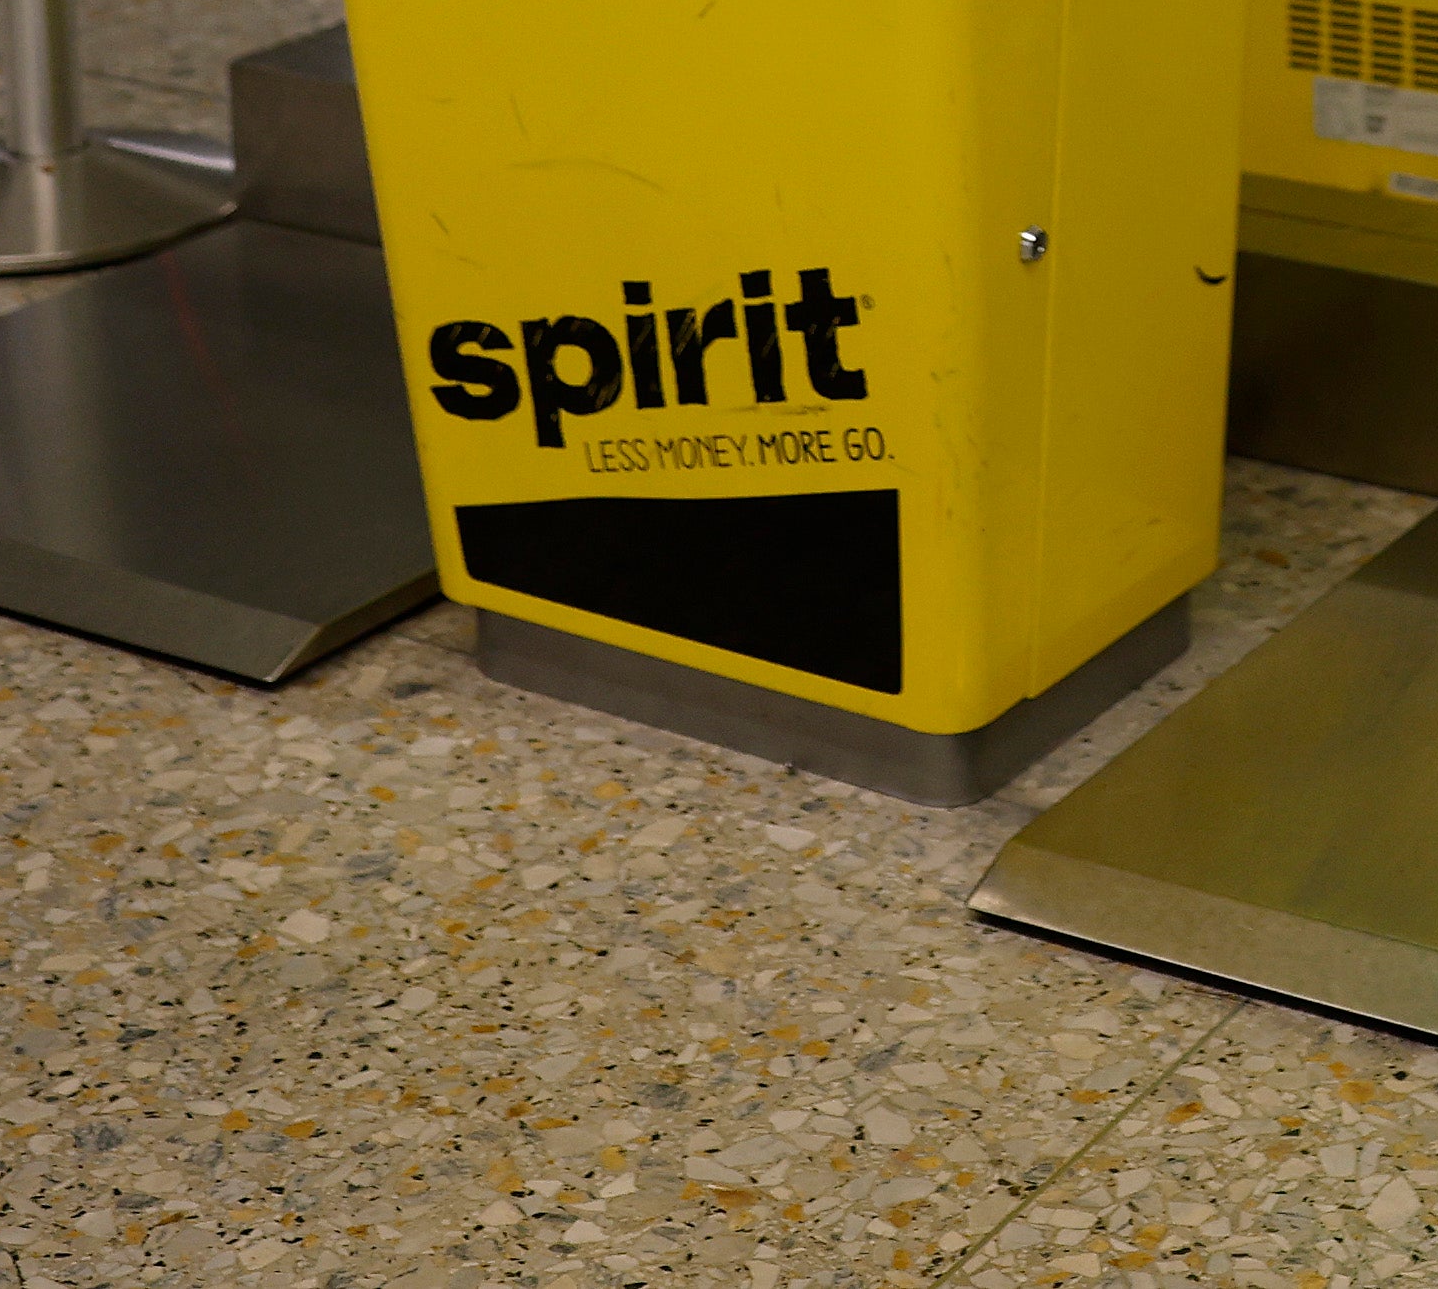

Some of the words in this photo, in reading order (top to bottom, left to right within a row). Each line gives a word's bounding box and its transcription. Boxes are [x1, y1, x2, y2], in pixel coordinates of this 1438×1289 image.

[428, 267, 870, 449] spirit
[582, 433, 652, 475] LESS
[756, 429, 837, 468] MORE
[844, 426, 895, 465] GO.
